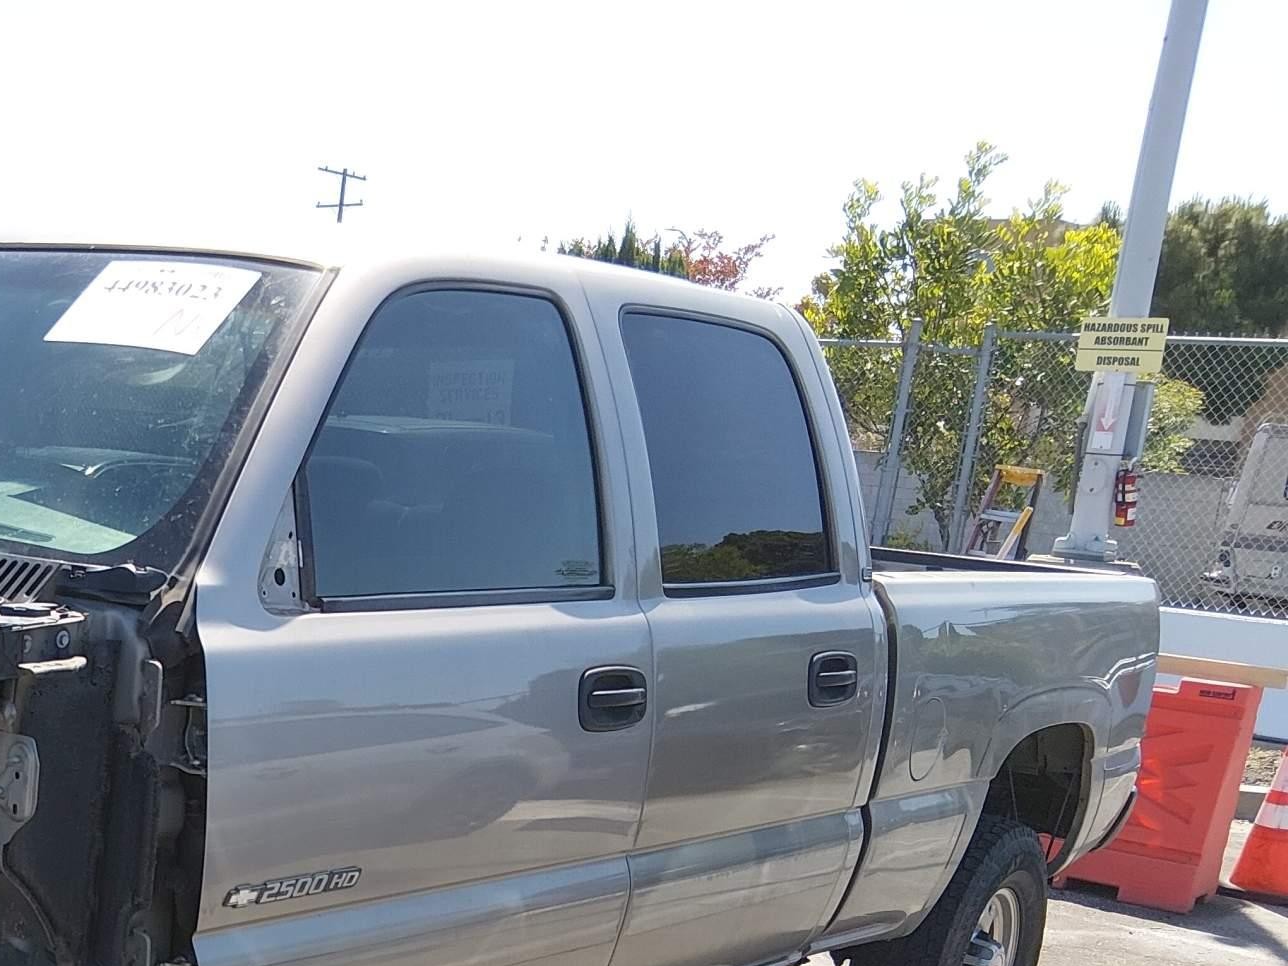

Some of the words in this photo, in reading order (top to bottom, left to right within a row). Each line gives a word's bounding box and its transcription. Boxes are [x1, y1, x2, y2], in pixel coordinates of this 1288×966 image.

[1083, 322, 1138, 333] HAZARDOUS
[1140, 323, 1164, 334] SPILL
[1094, 336, 1150, 347] ABSORBANT
[1096, 356, 1141, 367] DISPOSAL
